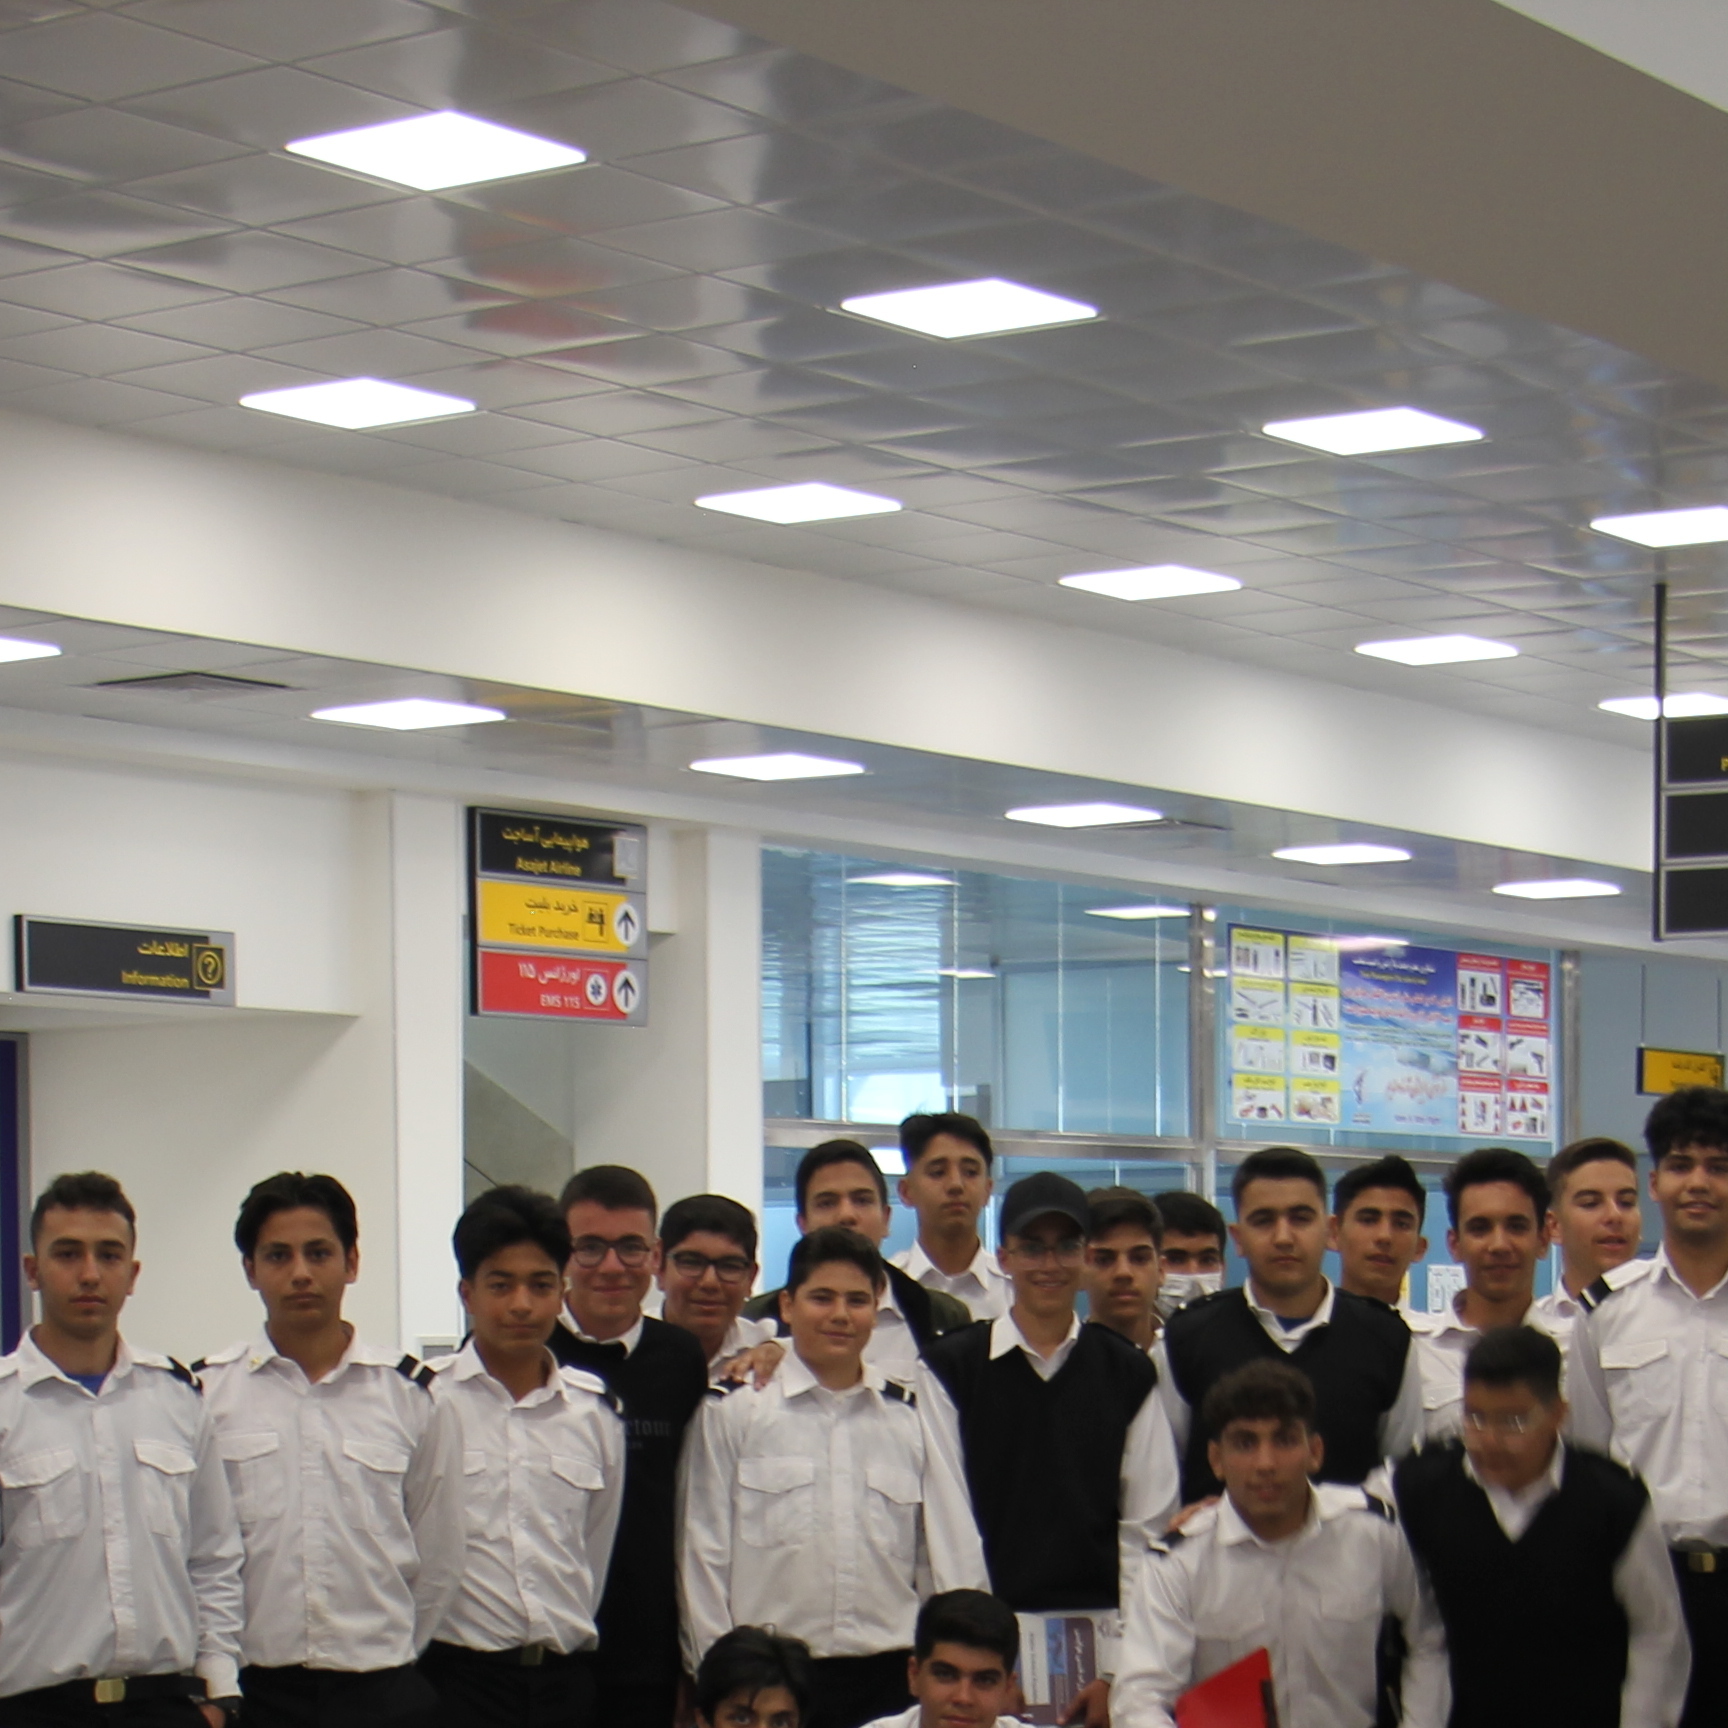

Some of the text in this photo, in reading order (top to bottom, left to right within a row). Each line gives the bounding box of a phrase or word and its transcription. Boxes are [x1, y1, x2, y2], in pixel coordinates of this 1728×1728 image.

[553, 899, 579, 916] خرید
[508, 923, 580, 941] Ticket Purchase
[136, 940, 190, 958] اطلاعات
[120, 970, 190, 989] Information
[540, 994, 561, 1008] EMS
